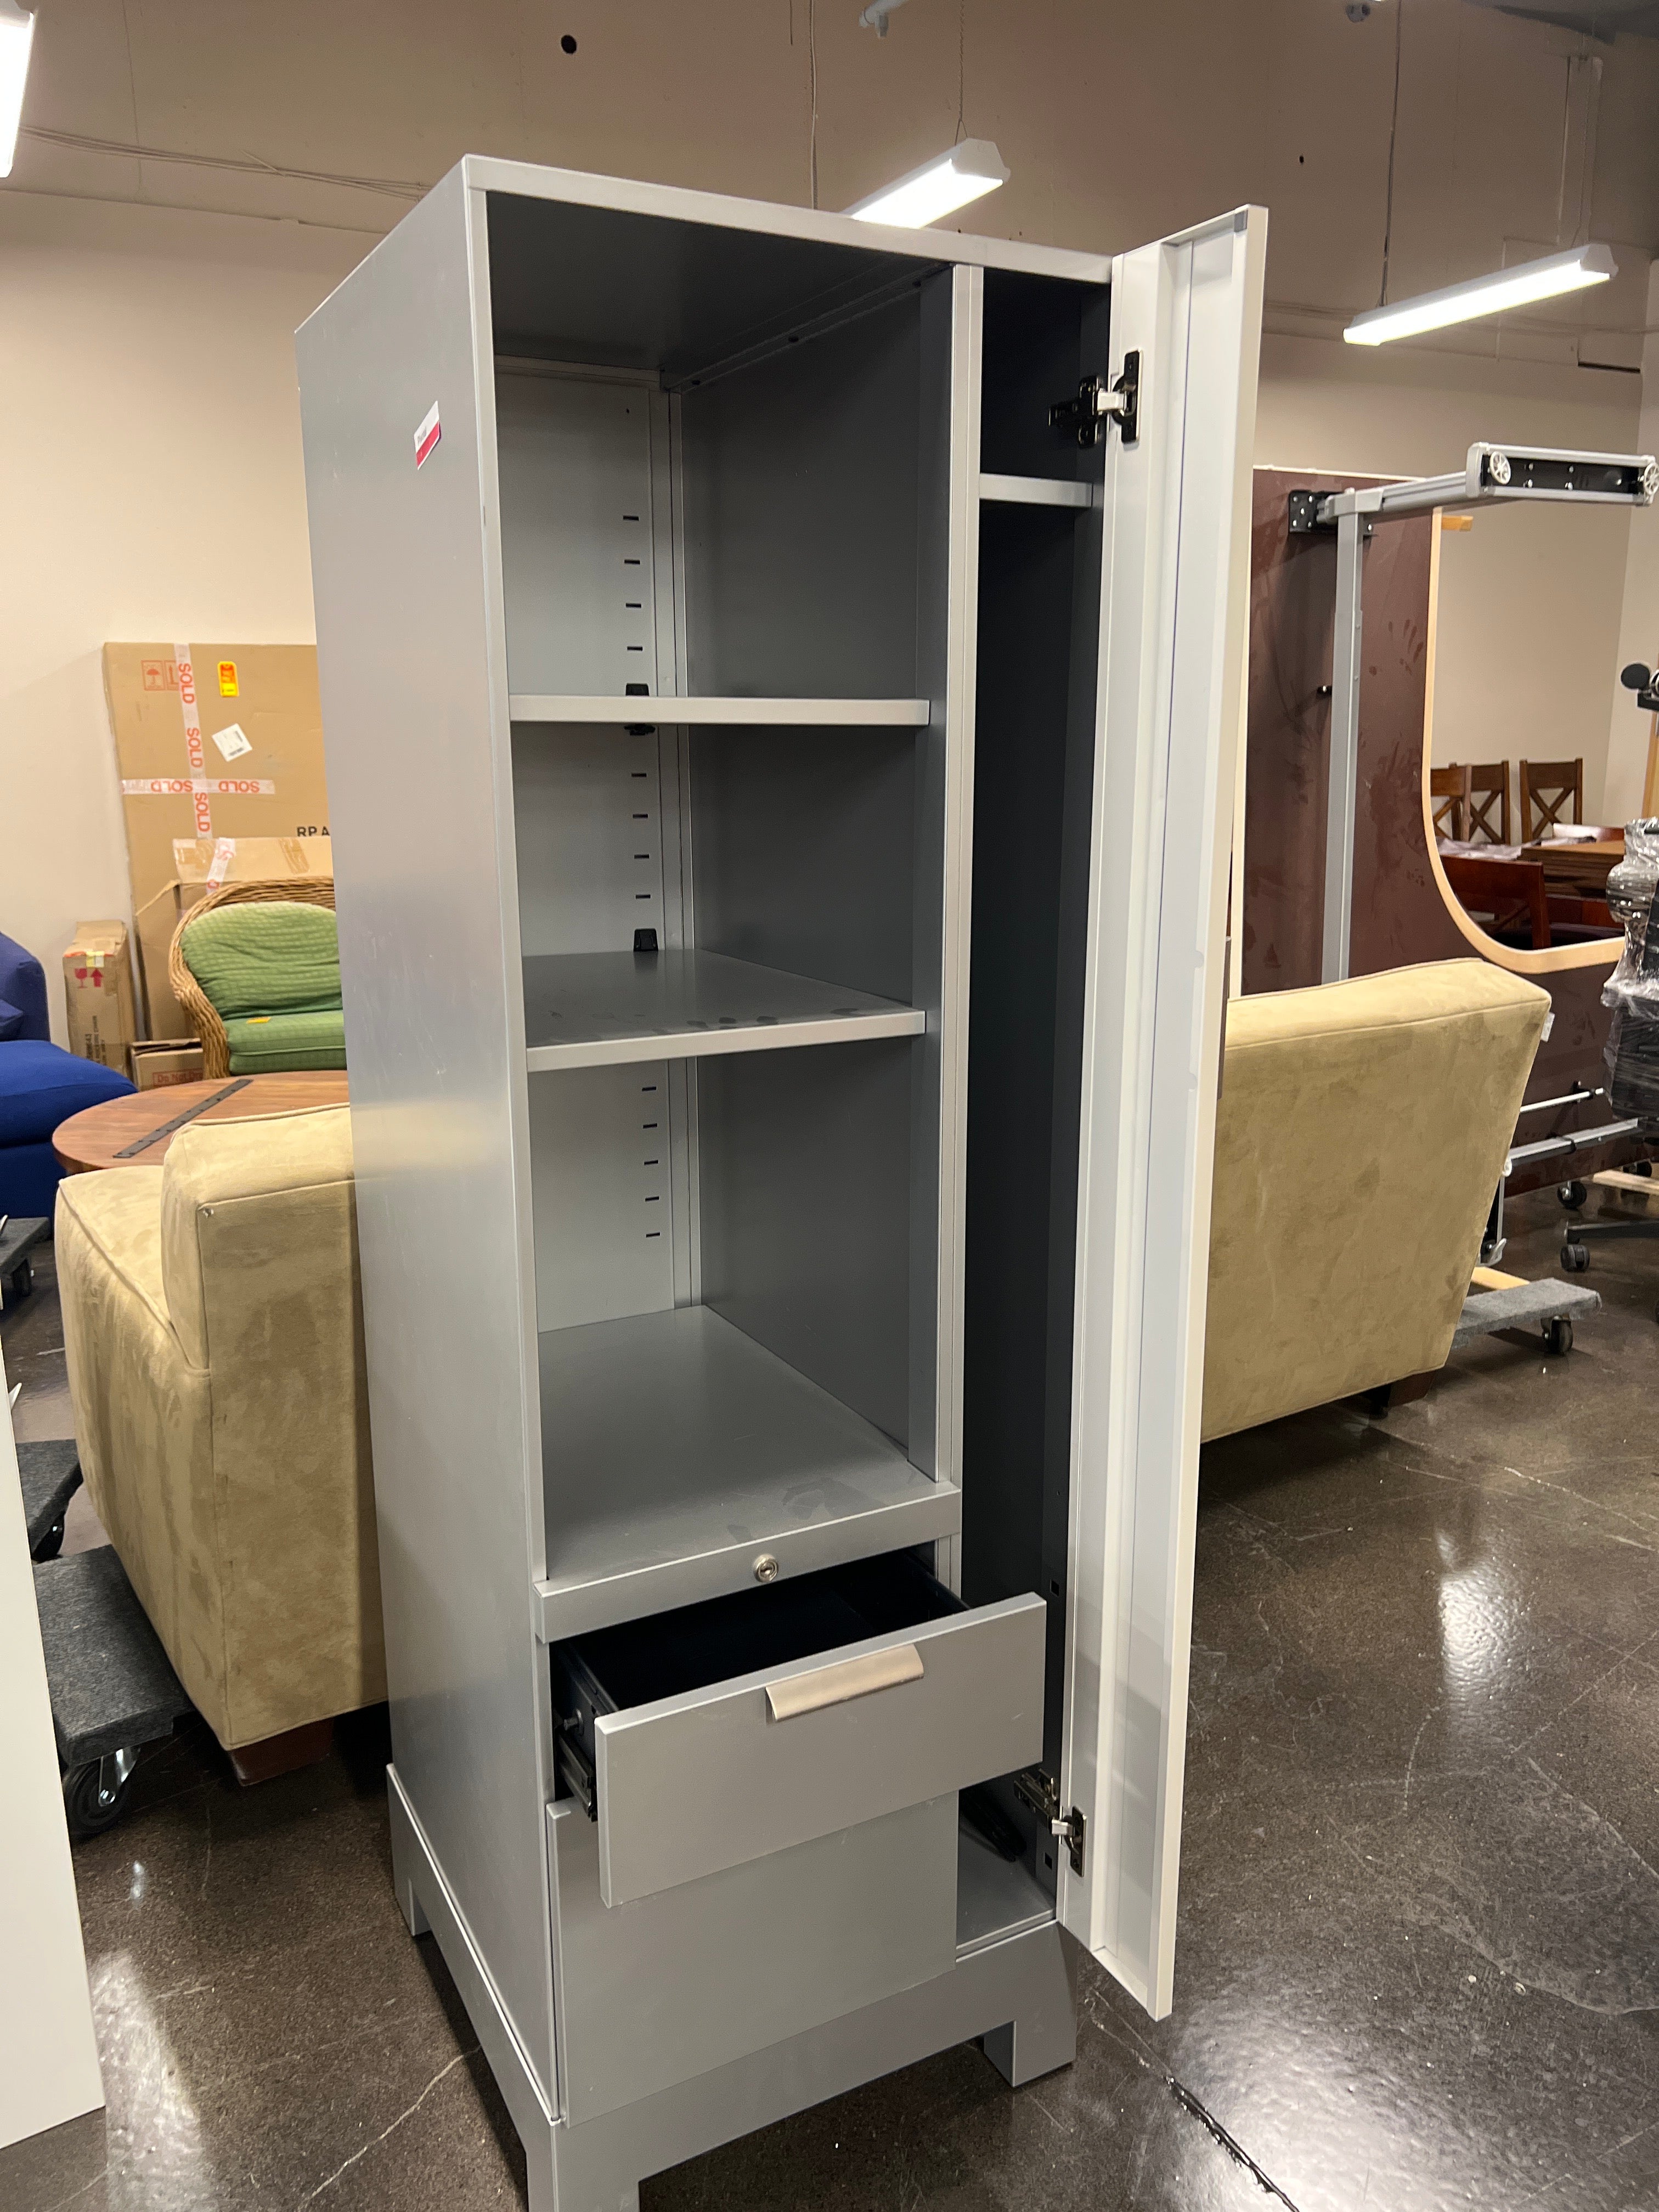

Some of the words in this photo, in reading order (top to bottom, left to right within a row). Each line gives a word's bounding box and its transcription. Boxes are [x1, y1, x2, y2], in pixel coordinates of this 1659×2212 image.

[178, 663, 195, 704] SOLD
[187, 727, 204, 768] SOLD
[150, 780, 193, 792] SOLD
[218, 781, 260, 793] SOLD
[195, 793, 210, 832] SOLD
